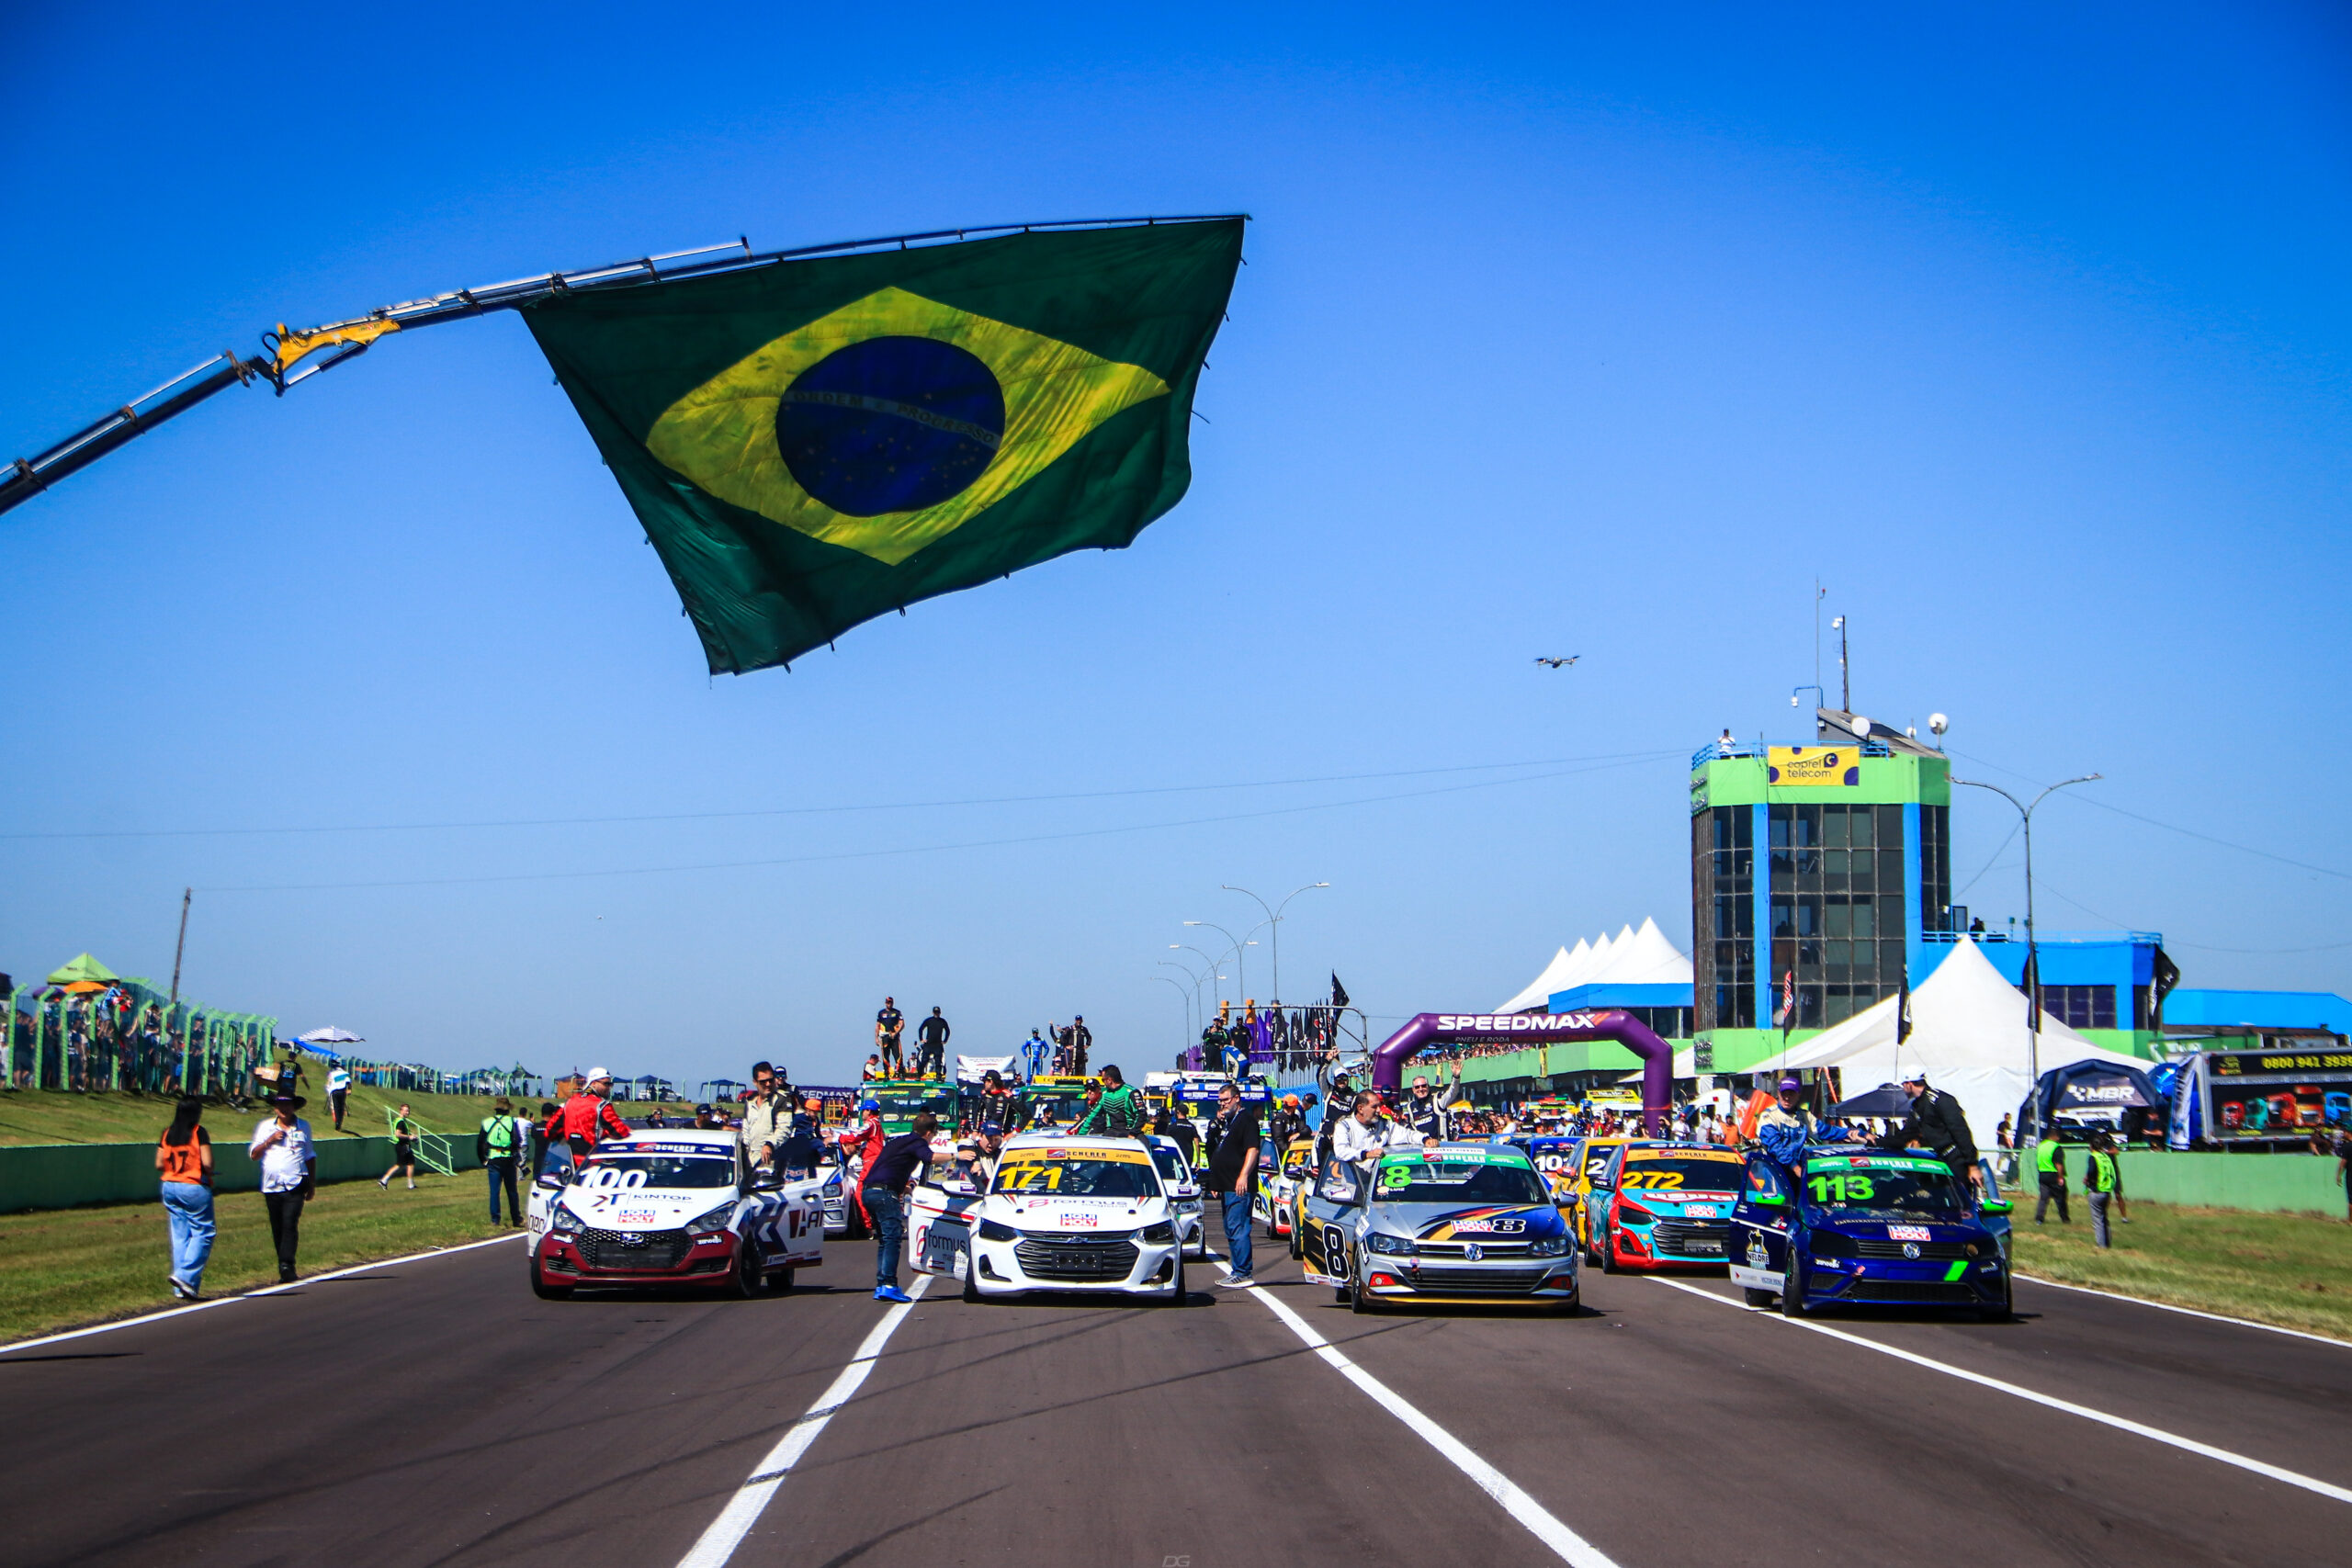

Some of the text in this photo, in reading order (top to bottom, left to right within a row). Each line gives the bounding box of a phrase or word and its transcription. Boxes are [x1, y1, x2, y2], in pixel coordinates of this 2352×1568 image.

[793, 391, 865, 408] ORDEM
[896, 402, 995, 444] PROGRESSO
[1787, 769, 1832, 778] telecom
[1437, 1013, 1597, 1031] SPEEDMAX
[2262, 1055, 2295, 1069] 0800
[2086, 1086, 2135, 1100] MBR
[1533, 1155, 1569, 1172] 10
[577, 1165, 648, 1189] 100
[998, 1166, 1063, 1190] 171
[1384, 1166, 1412, 1187] 8
[1621, 1171, 1684, 1190] 272
[633, 1193, 693, 1201] KINTOP
[1807, 1175, 1875, 1202] 113
[1053, 1198, 1128, 1206] formus
[618, 1215, 654, 1224] MOLY
[1493, 1219, 1527, 1234] 8
[928, 1229, 967, 1254] formus
[1891, 1232, 1930, 1241] MOLY
[1322, 1223, 1351, 1283] 8
[1747, 1250, 1770, 1265] NELORE
